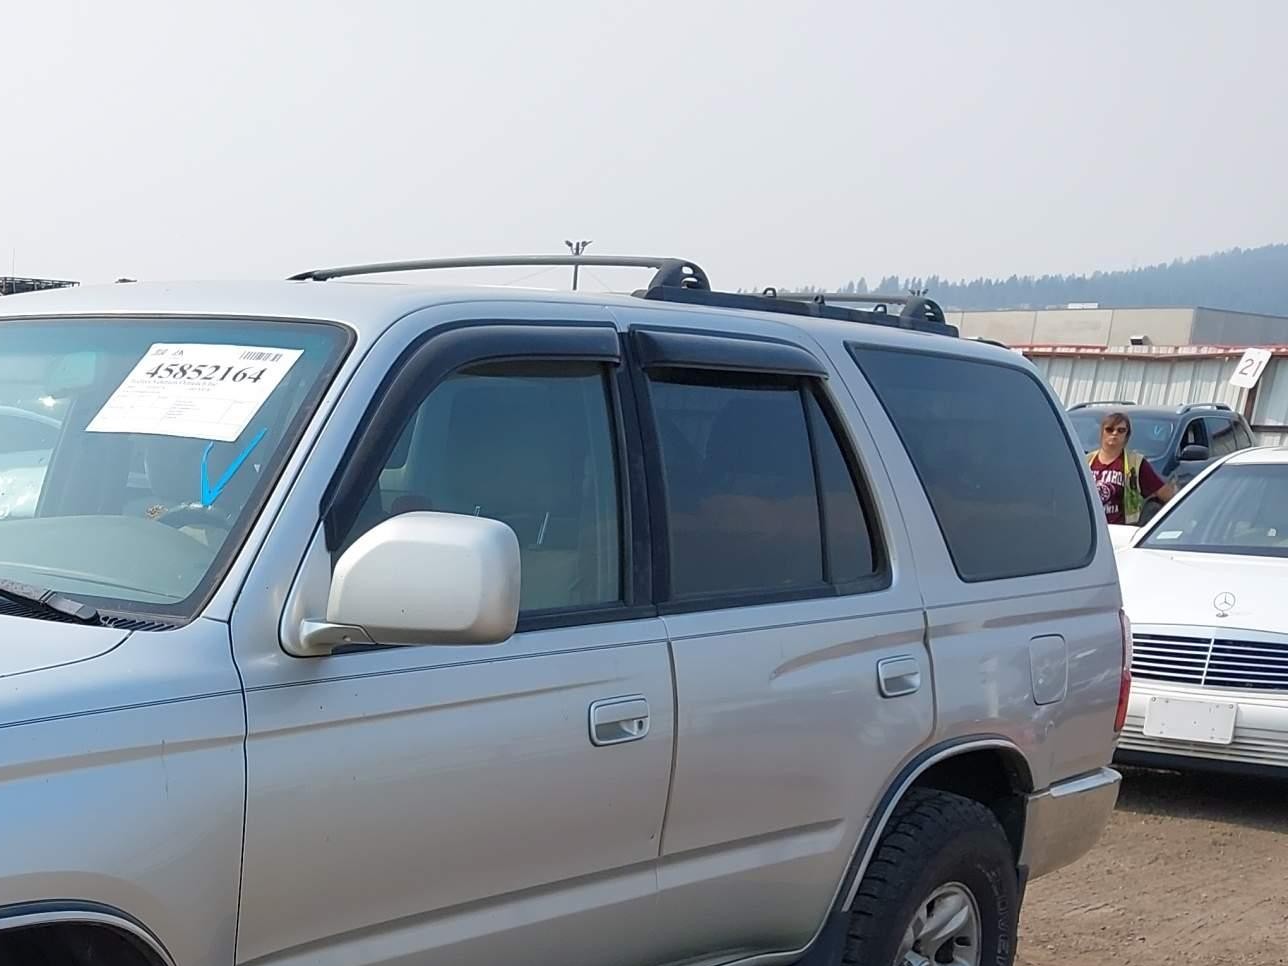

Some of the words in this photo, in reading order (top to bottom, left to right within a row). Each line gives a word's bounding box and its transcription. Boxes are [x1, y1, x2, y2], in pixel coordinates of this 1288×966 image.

[145, 362, 268, 385] 45852164
[1238, 358, 1263, 378] 21
[1101, 470, 1125, 487] TABO
